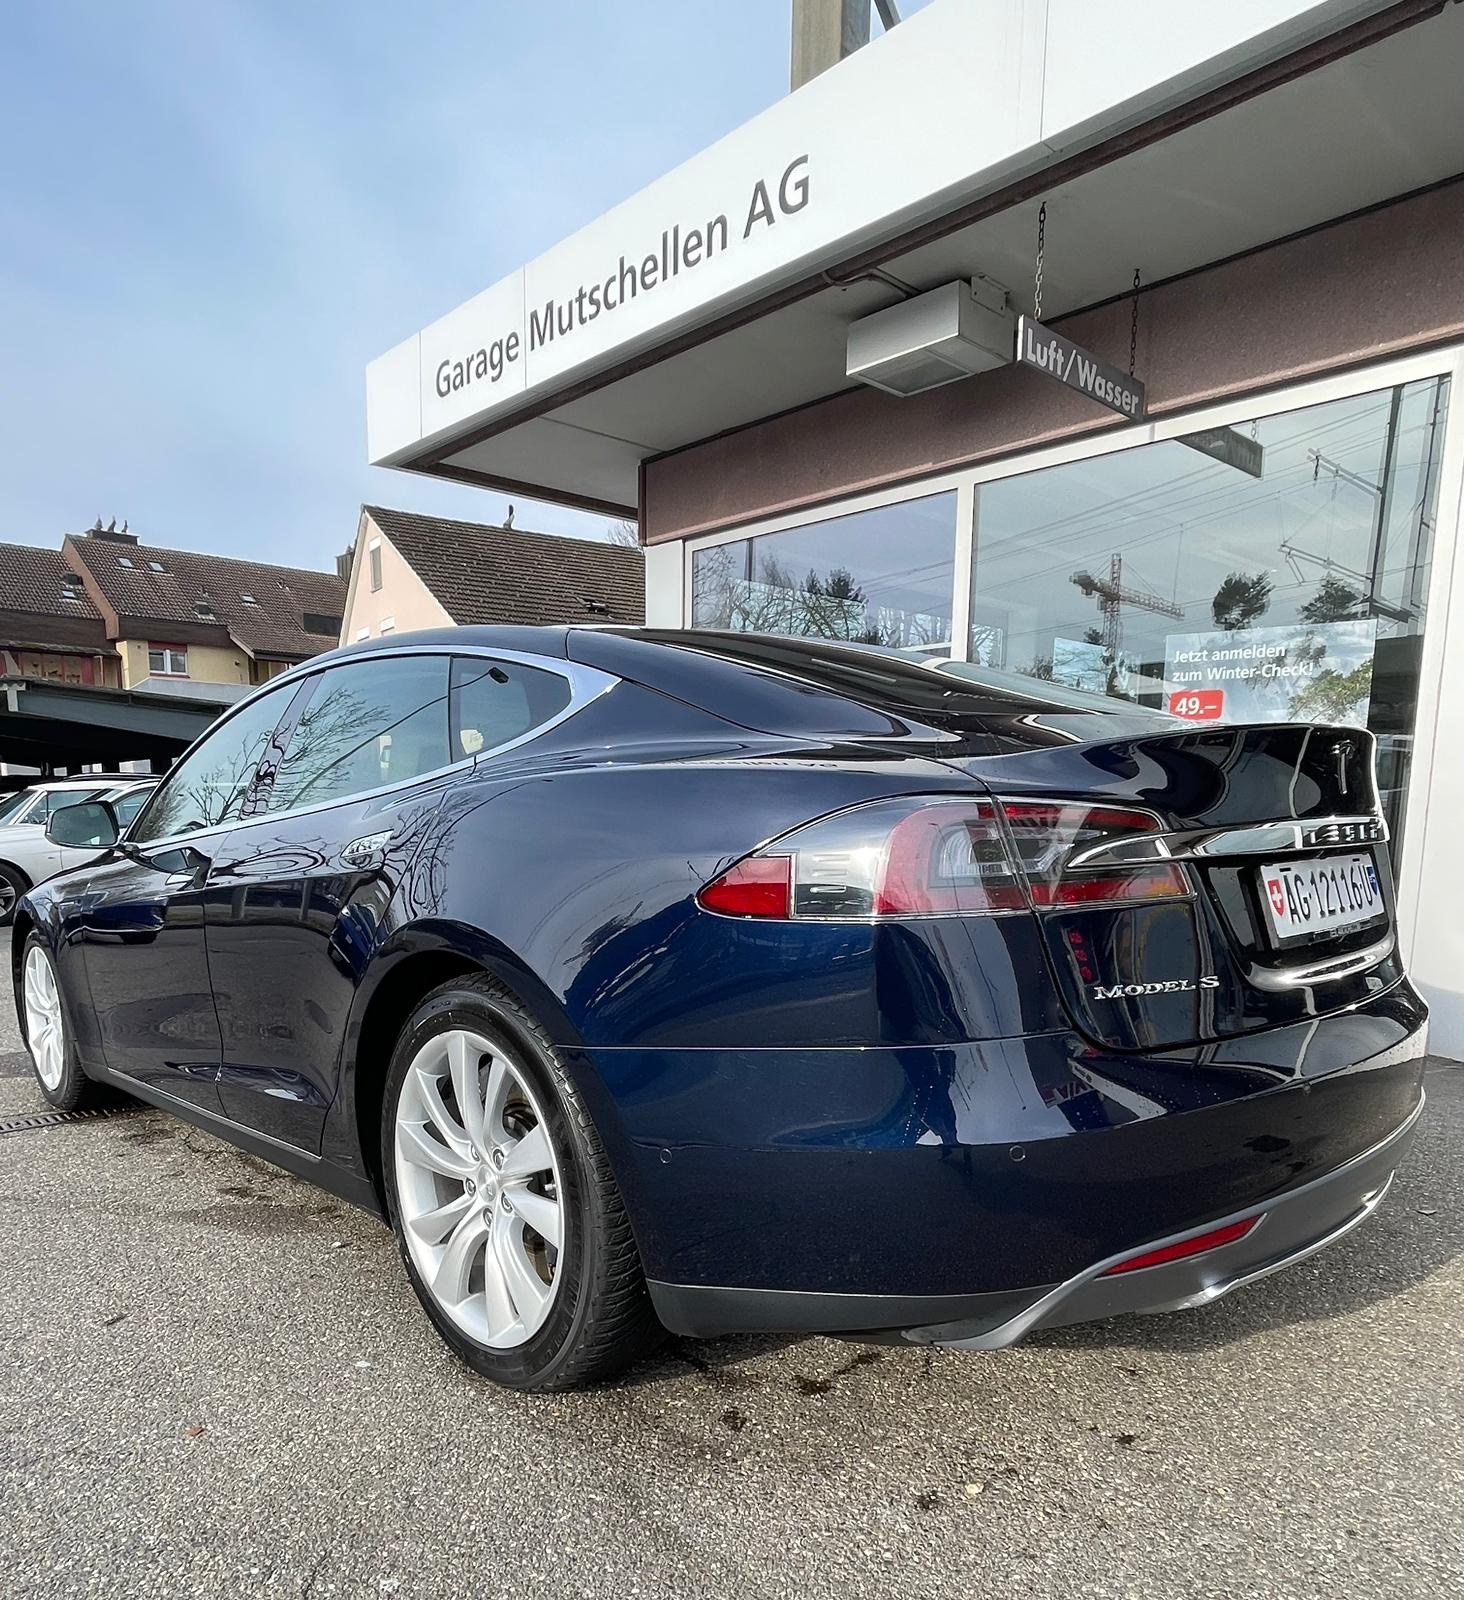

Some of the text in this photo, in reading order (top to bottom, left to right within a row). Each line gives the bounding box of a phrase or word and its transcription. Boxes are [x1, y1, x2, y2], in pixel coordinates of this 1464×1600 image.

[435, 154, 809, 398] Garage Mutschellen AG
[1026, 327, 1139, 415] Luft/Wasser
[1173, 643, 1286, 664] Jetzt anmelden
[1172, 663, 1314, 682] zum Winter-Check!
[1093, 975, 1221, 1000] MODEL S
